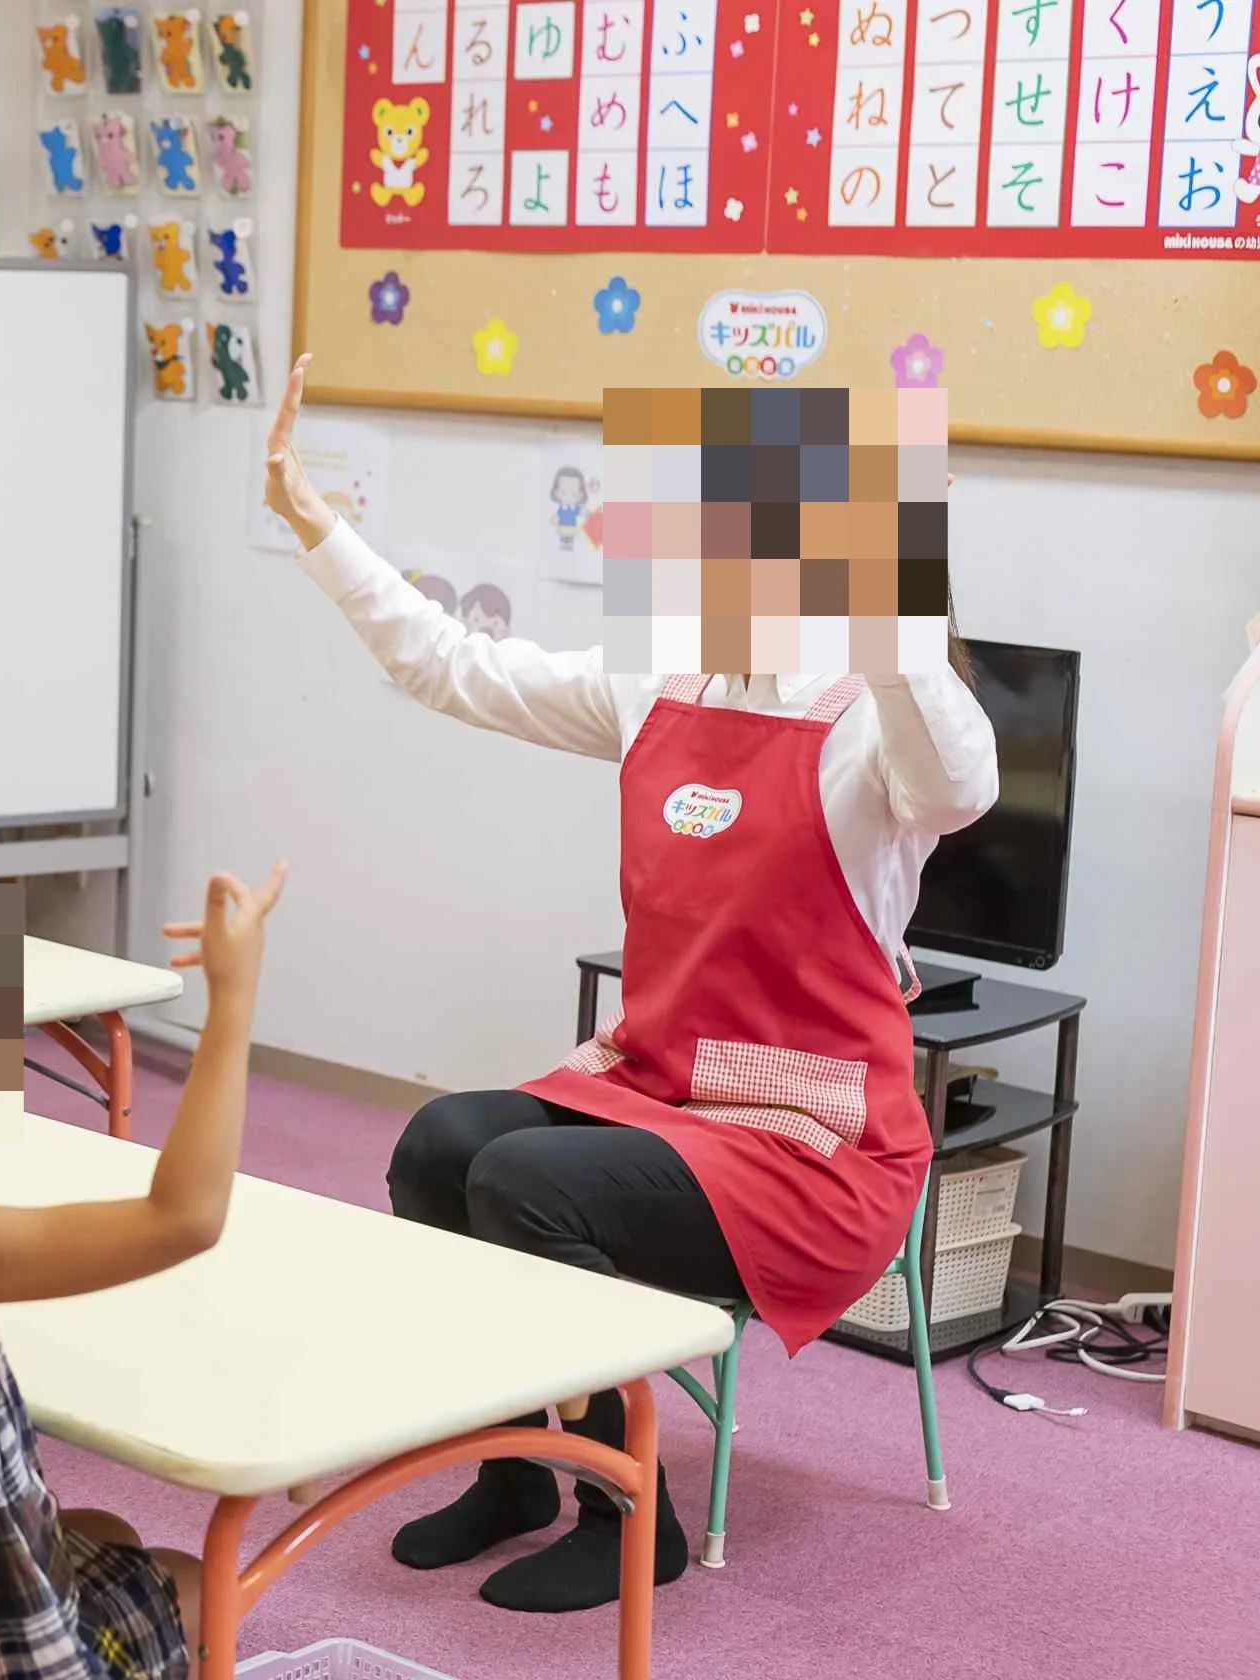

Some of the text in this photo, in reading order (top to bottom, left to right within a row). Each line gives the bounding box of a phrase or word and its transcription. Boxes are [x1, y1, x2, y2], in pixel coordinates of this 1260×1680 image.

[466, 21, 491, 65] る
[528, 16, 561, 59] ゆ
[597, 14, 629, 61] む
[662, 12, 702, 55] ふ
[850, 1, 893, 46] ぬ
[930, 9, 971, 40] つ
[1012, 0, 1058, 46] す
[1109, 0, 1128, 44] く
[404, 24, 436, 69] ん
[461, 93, 494, 136] れ
[591, 92, 627, 129] め
[660, 100, 698, 124] へ
[847, 81, 887, 129] ね
[929, 82, 964, 129] て
[1005, 74, 1052, 126] せ
[1094, 72, 1140, 125] け
[1185, 67, 1226, 123] え
[461, 164, 489, 212] ろ
[524, 164, 550, 211] よ
[595, 163, 618, 212] も
[659, 164, 693, 209] ほ
[840, 166, 881, 207] の
[927, 164, 955, 208] と
[1002, 162, 1043, 212] そ
[1096, 162, 1125, 208] こ
[1178, 156, 1224, 212] お
